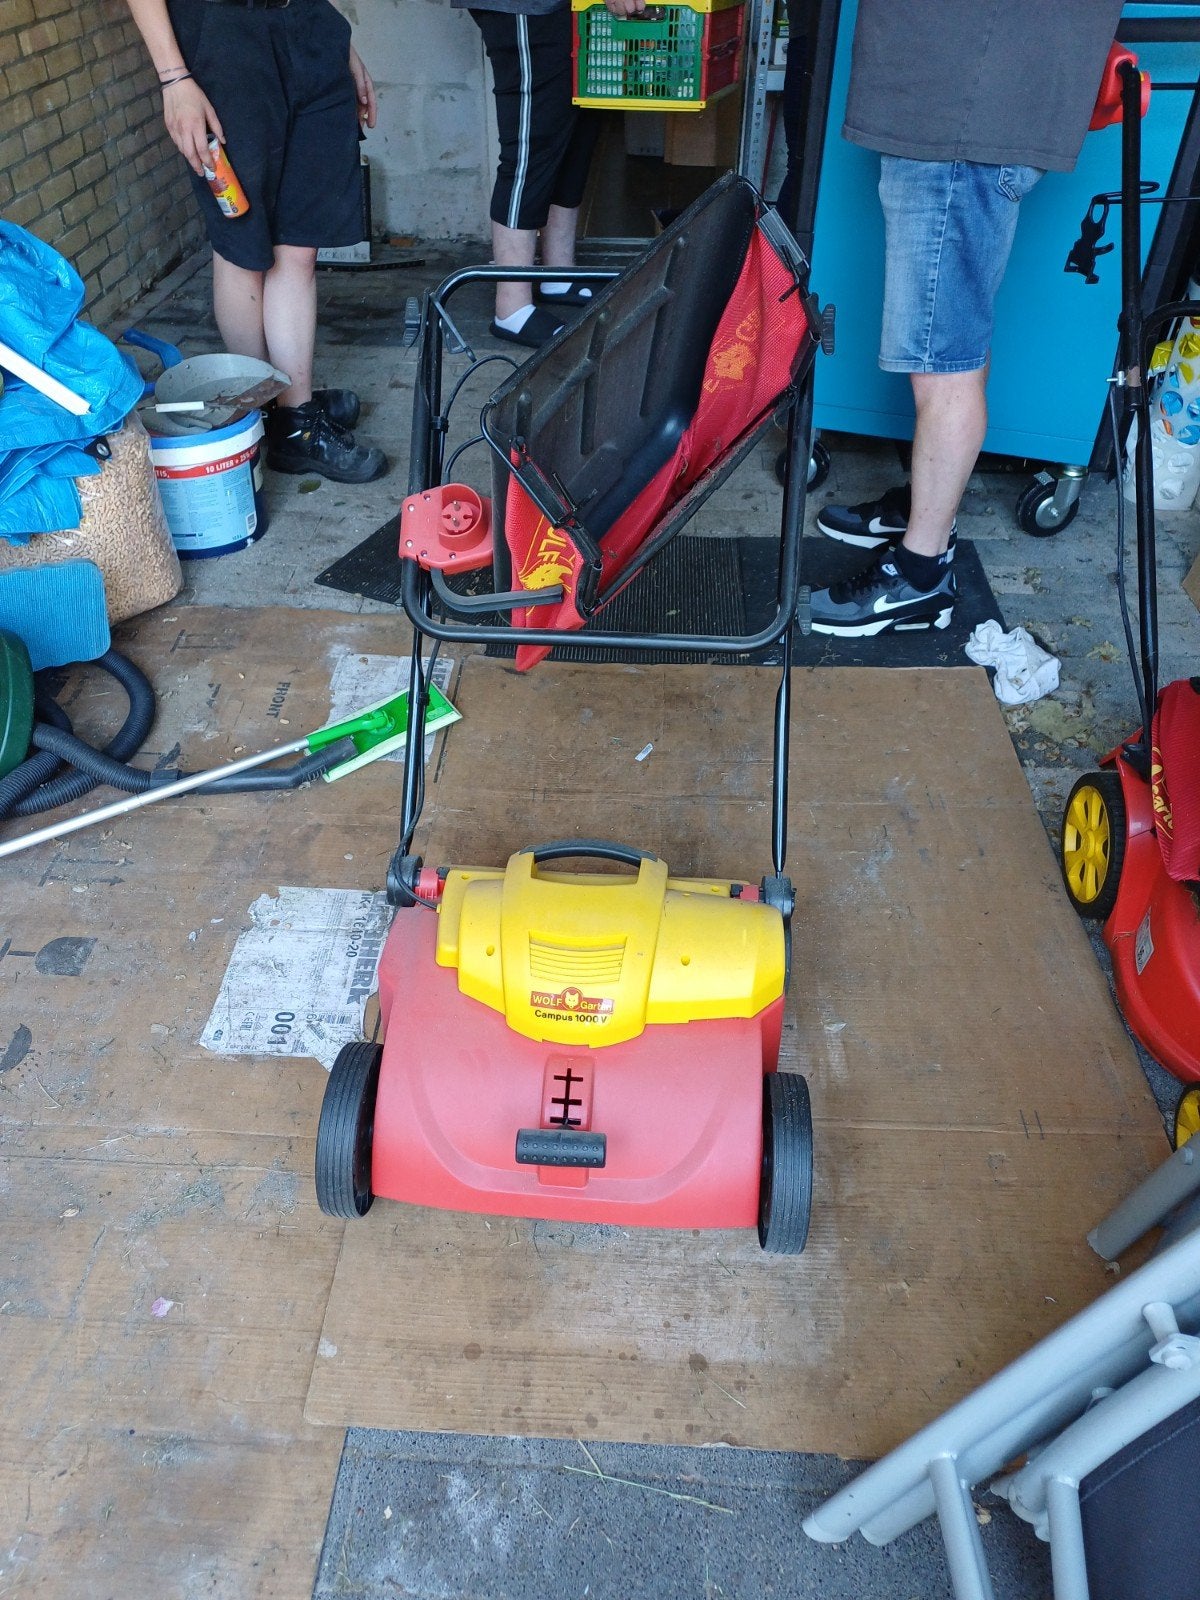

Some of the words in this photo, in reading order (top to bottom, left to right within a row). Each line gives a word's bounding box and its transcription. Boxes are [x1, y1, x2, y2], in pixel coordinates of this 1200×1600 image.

[205, 466, 215, 474] 10
[216, 459, 235, 471] LITER
[266, 681, 291, 718] FRONT
[532, 994, 562, 1007] WOLF
[534, 1009, 573, 1022] Campus
[575, 1014, 599, 1023] 1000
[600, 1015, 608, 1023] V
[267, 1011, 296, 1045] 001
